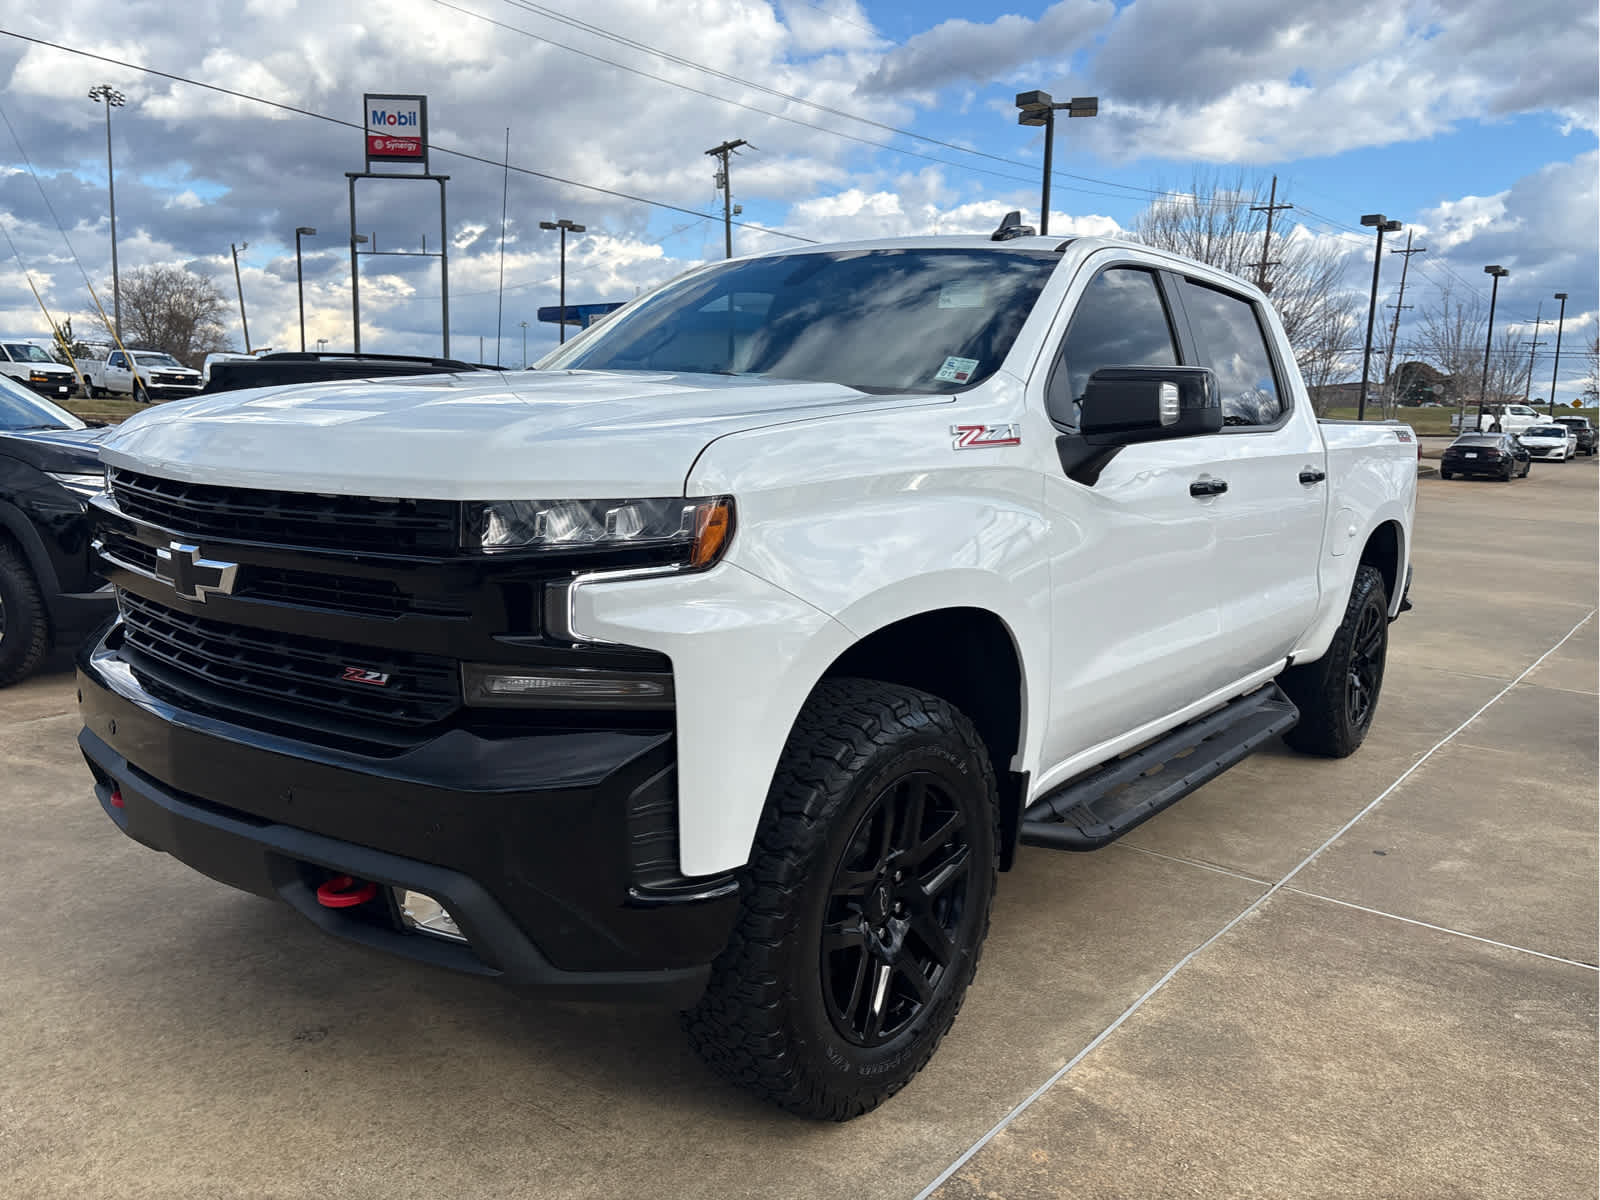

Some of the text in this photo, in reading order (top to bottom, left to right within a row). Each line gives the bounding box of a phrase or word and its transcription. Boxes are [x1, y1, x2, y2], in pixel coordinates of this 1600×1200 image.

[372, 110, 417, 126] Mobil
[385, 140, 417, 152] Synergy
[950, 423, 1021, 451] Z71
[342, 666, 391, 686] Z71
